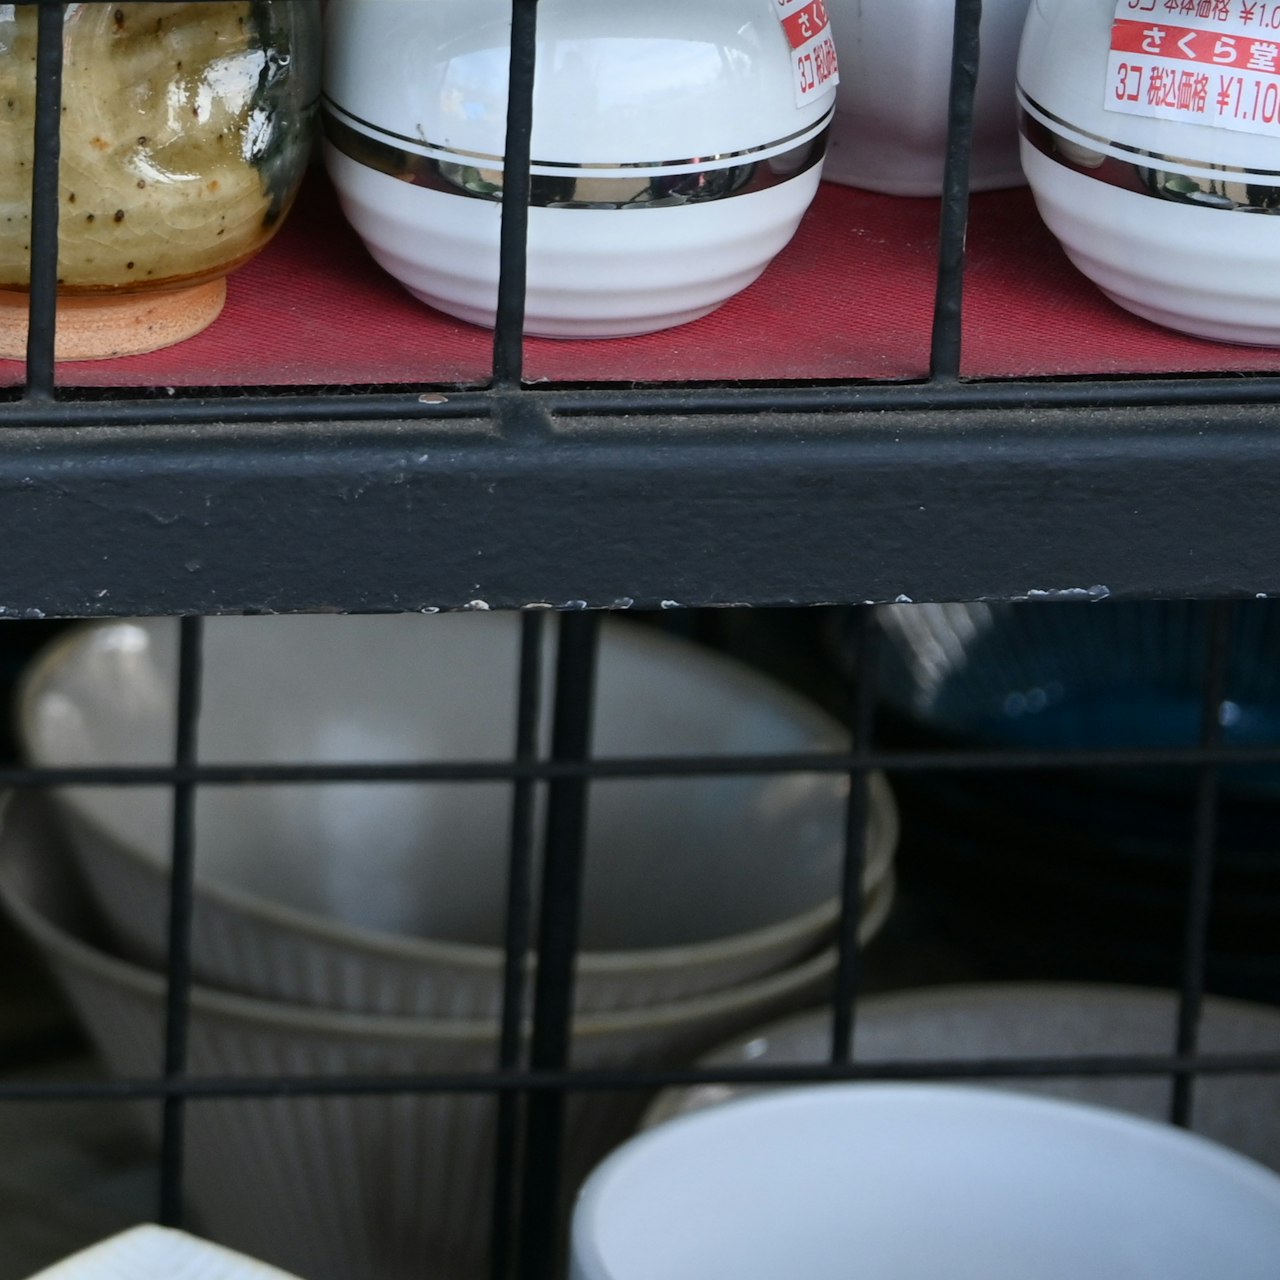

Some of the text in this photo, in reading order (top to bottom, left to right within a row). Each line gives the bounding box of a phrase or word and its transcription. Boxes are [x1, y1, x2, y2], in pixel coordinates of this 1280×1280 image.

[1141, 27, 1280, 72] さくら堂
[1115, 62, 1280, 124] 3コ 税込価格 ¥1.10
